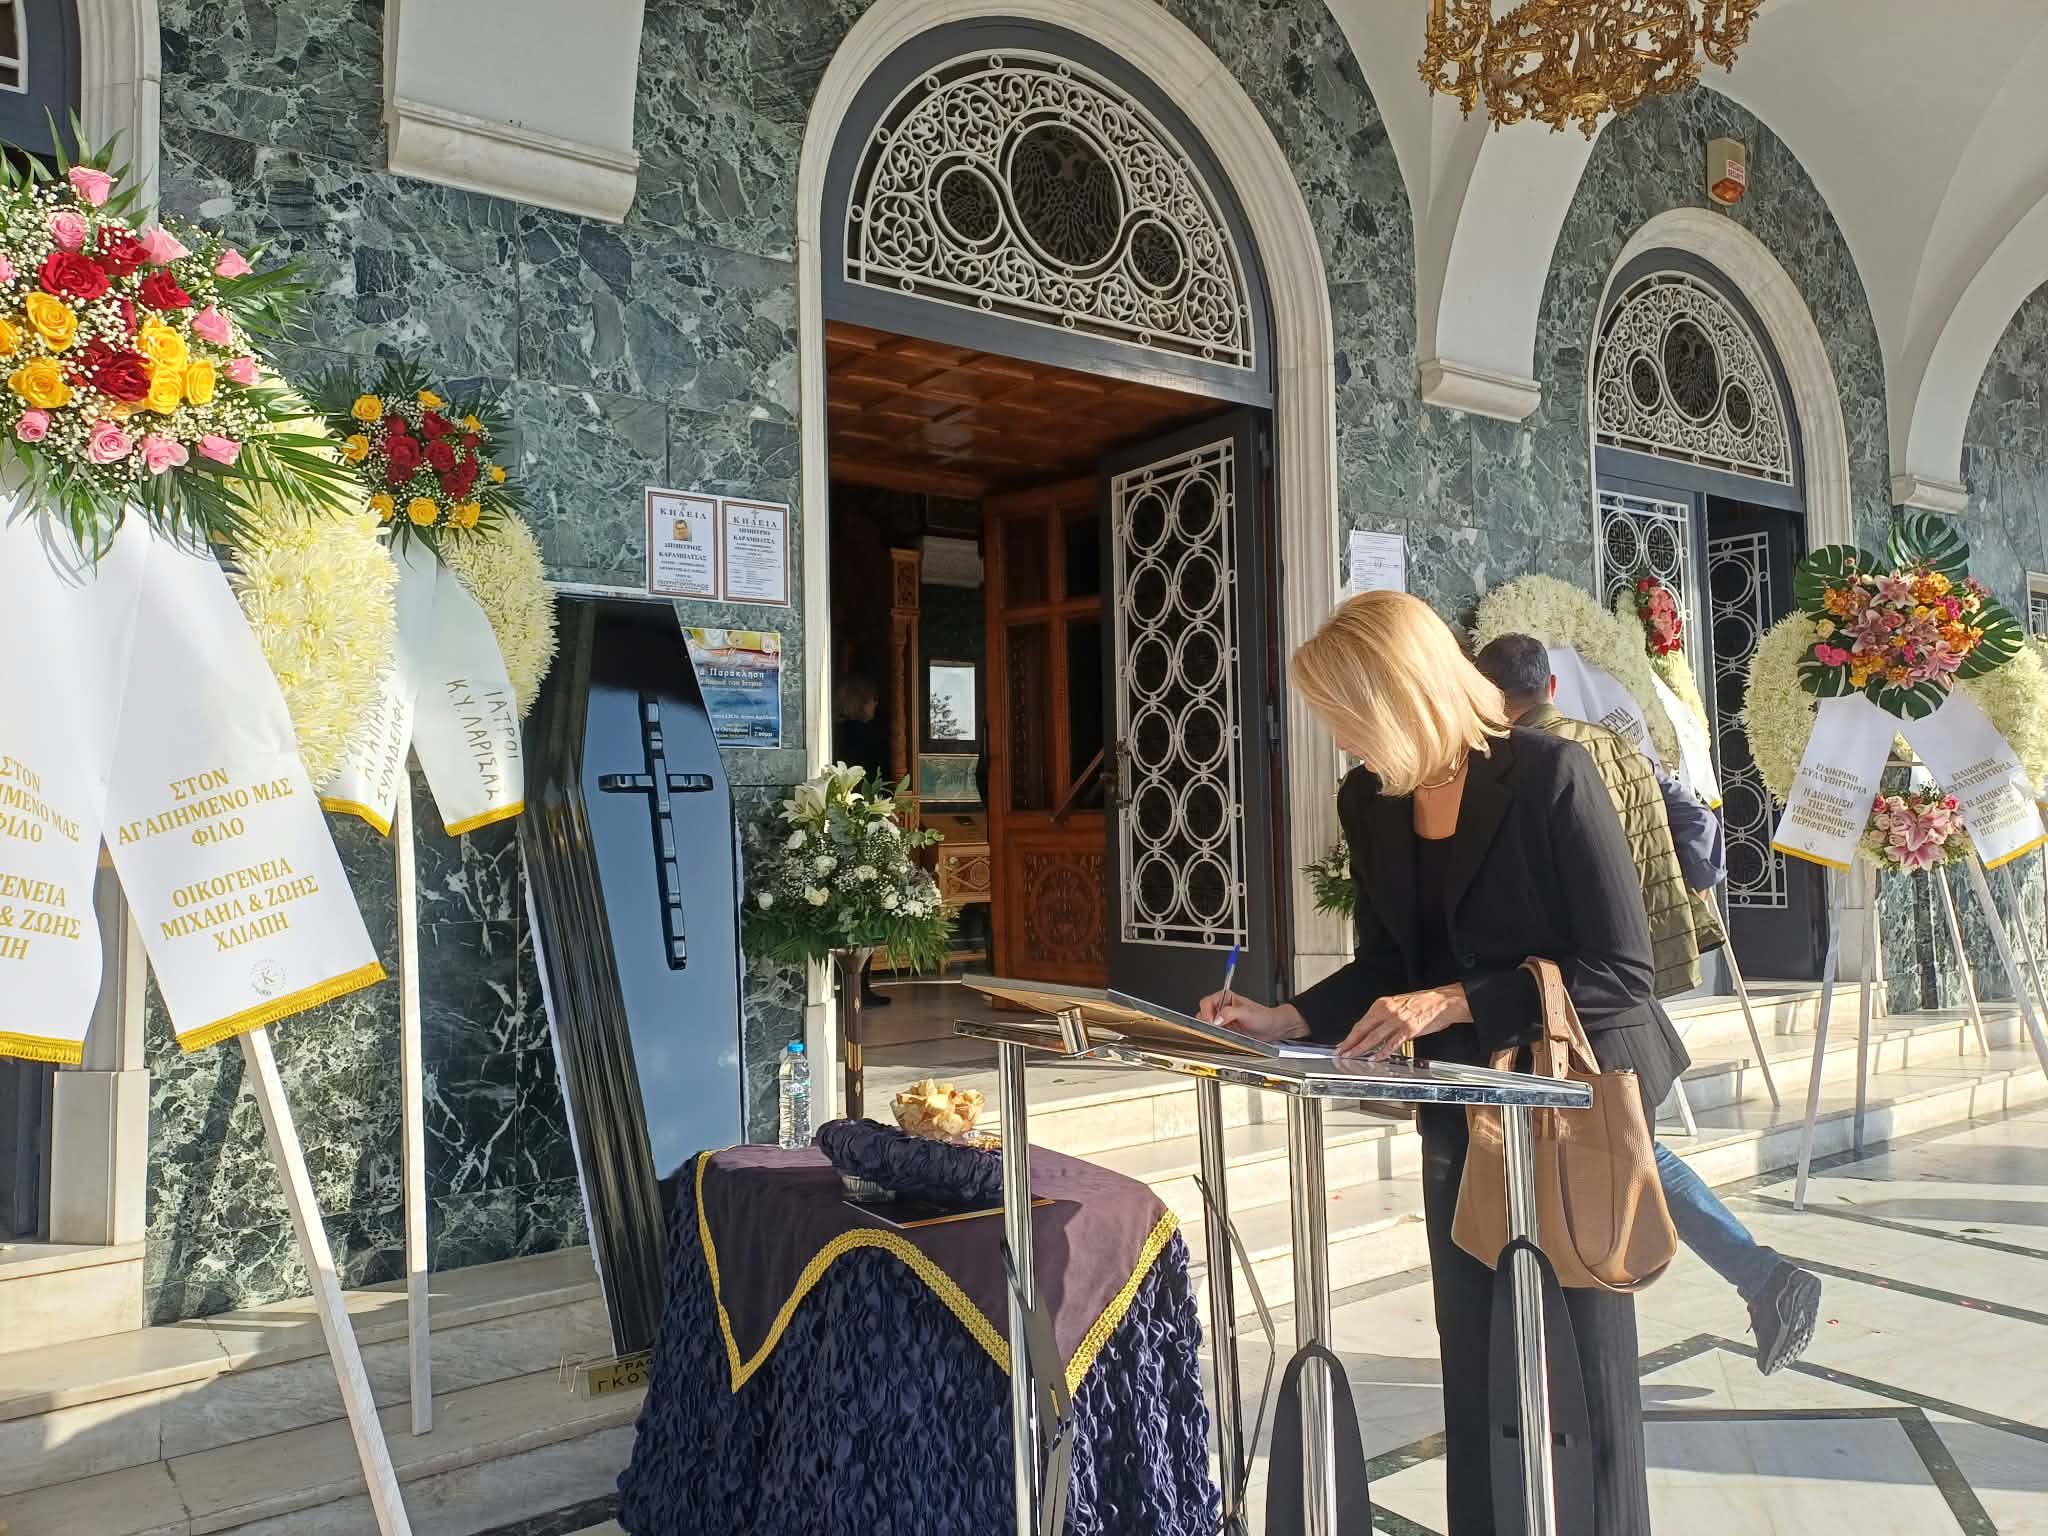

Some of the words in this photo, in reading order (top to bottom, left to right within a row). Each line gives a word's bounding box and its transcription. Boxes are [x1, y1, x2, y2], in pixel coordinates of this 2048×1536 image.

[660, 508, 707, 520] ΚΗΔΕΙΑ
[733, 516, 777, 528] ΚΗΔΕΙΑ
[484, 690, 520, 759] ΙΑΤΡΟΙ
[0, 756, 41, 794] ΣΤΟΝ
[169, 767, 230, 801] ΣΤΟΝ
[118, 789, 249, 845] ΑΓΑΠΗΜΕΝΟ
[251, 777, 294, 804] ΜΑΣ
[1807, 798, 1825, 811] ΤΗΣ
[51, 809, 80, 844] ΜΑΣ
[191, 816, 246, 847] ΦΙΛΟ
[0, 873, 66, 908] ΕΝΕΙΑ
[171, 857, 294, 908] ΟΙΚΟΓΕΝΕΙΑ
[19, 908, 81, 940] ΖΩΗΣ
[159, 898, 246, 941] ΜΙΧΑΗΛ
[249, 893, 265, 913] &
[264, 875, 320, 908] ΖΩΗΣ
[213, 911, 290, 952] ΧΛΙΑΠΗ
